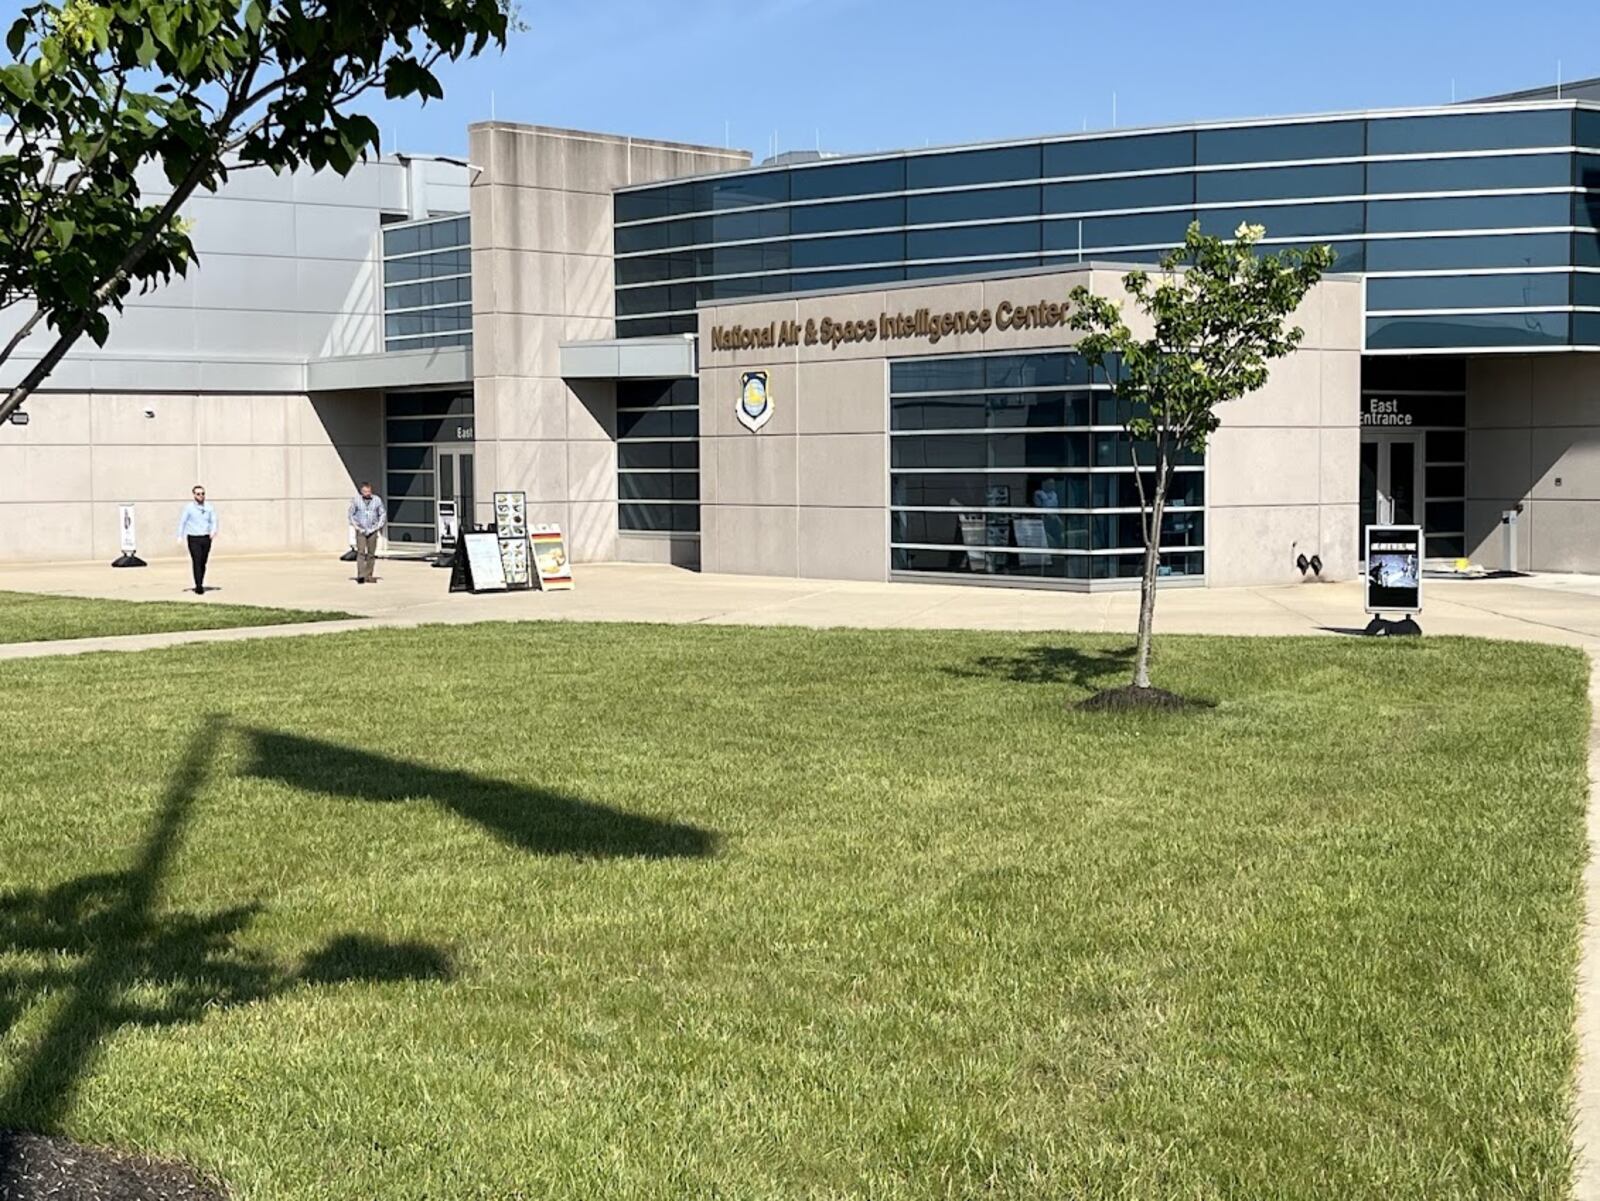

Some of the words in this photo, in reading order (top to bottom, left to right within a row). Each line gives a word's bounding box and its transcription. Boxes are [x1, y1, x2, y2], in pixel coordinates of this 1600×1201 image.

[711, 321, 774, 352] National
[777, 320, 802, 348] Air
[804, 318, 818, 346] &
[820, 316, 877, 350] Space
[879, 308, 992, 344] Intelligence
[995, 299, 1070, 331] Center
[1370, 398, 1398, 413] East
